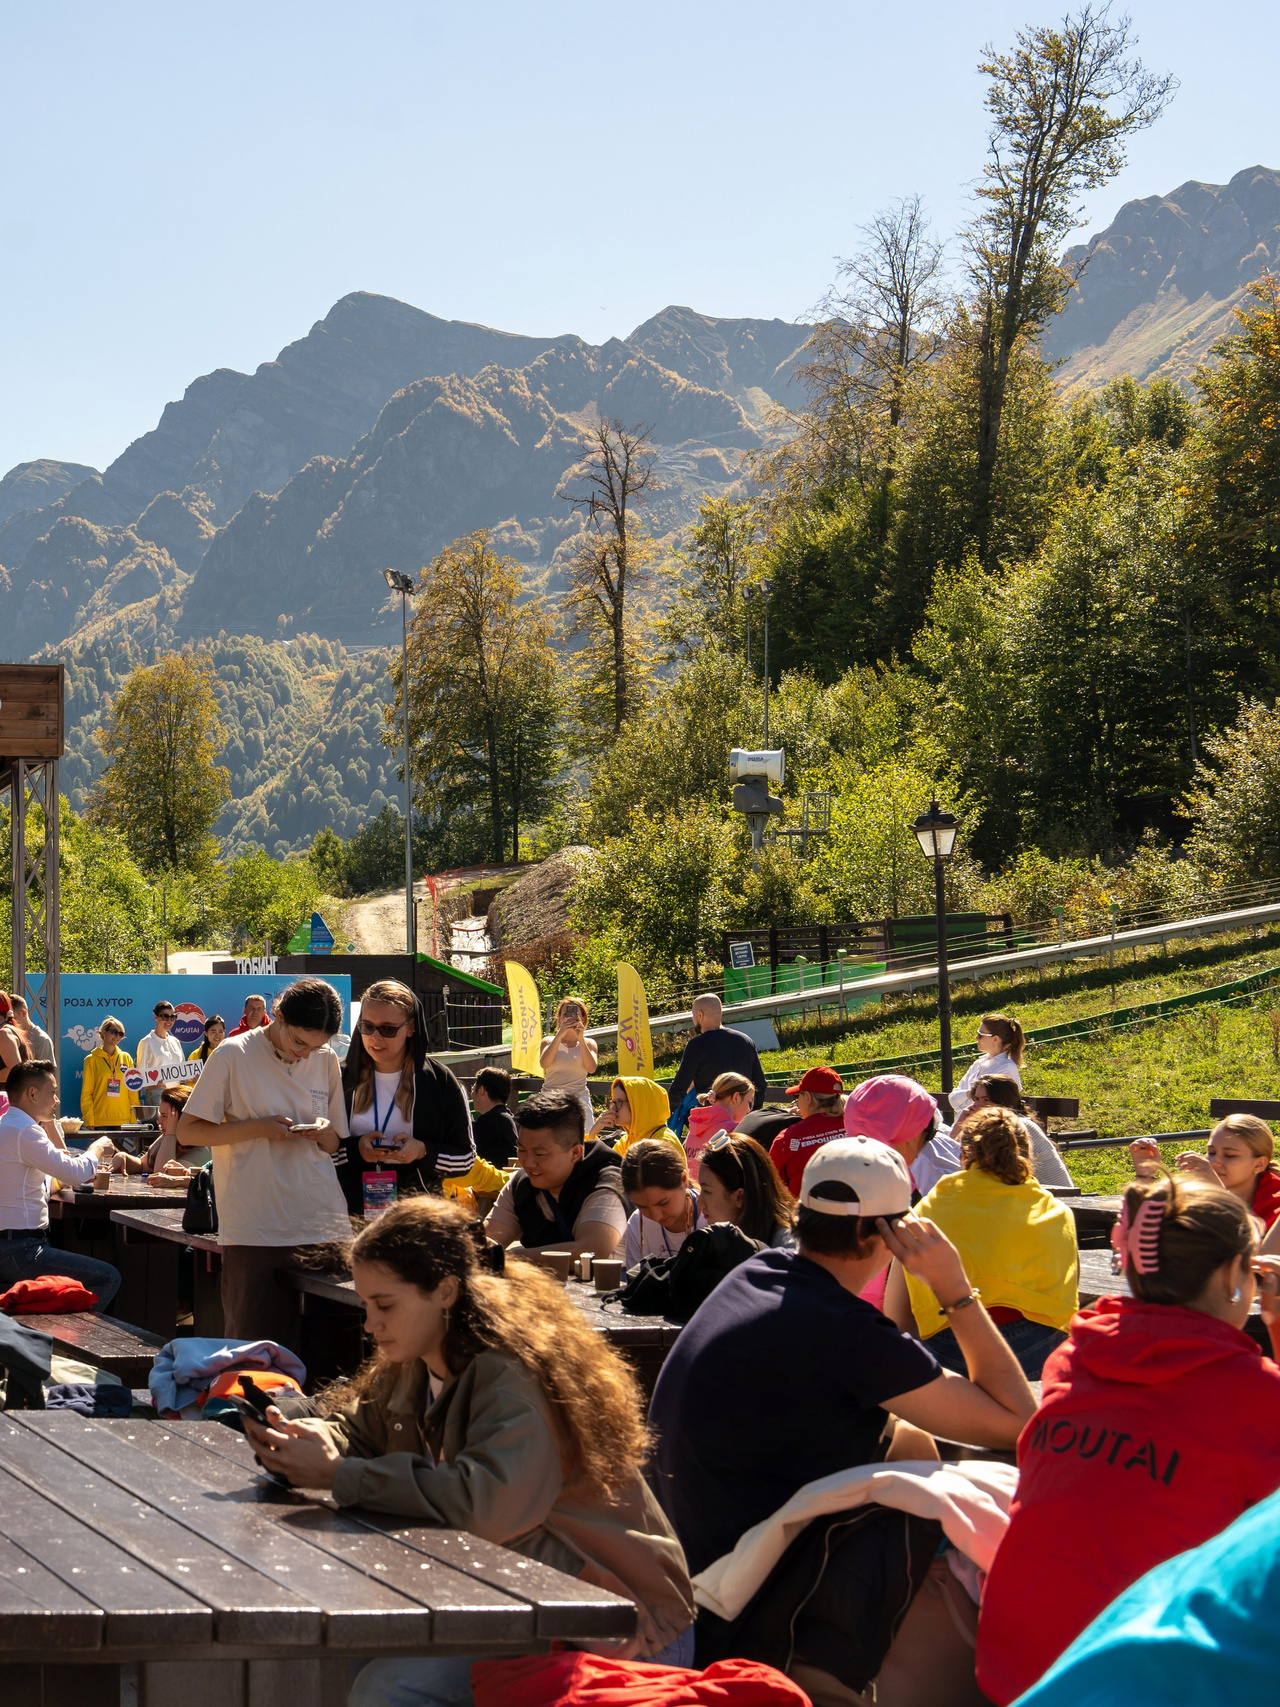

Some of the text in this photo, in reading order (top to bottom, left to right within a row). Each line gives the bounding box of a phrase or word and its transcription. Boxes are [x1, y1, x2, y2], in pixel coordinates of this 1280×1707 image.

[235, 956, 279, 974] ТЮБИНГ
[64, 998, 134, 1007] РОЗА ХУТОР
[161, 1061, 204, 1080] MOUTAI
